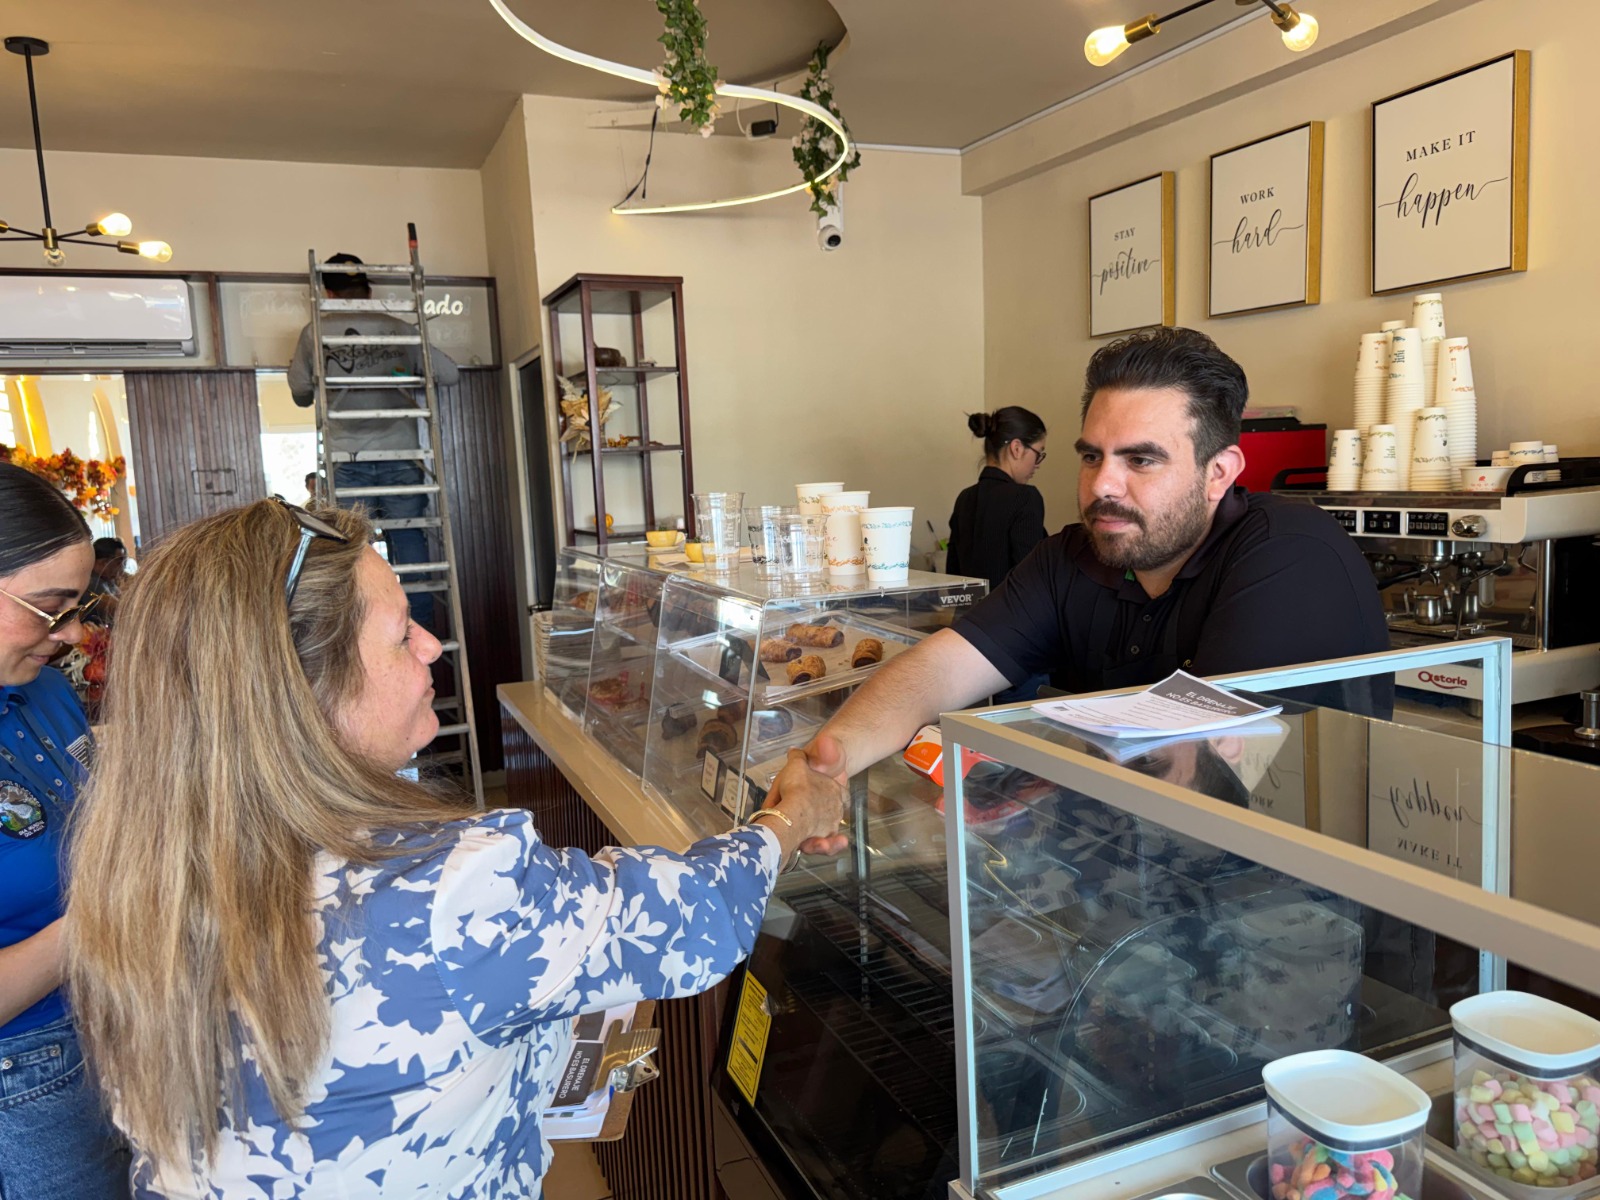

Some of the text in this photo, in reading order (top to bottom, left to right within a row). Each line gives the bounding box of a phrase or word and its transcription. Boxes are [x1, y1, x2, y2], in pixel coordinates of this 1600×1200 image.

[1405, 130, 1477, 162] MAKE IT
[1240, 187, 1275, 205] WORK
[1378, 172, 1509, 229] happen
[1114, 227, 1136, 241] STAY
[1213, 208, 1304, 254] hard
[1092, 247, 1160, 296] positive
[940, 594, 972, 604] VEVOR
[1166, 692, 1181, 700] NO
[1185, 691, 1197, 699] EL
[575, 1050, 583, 1059] NO
[559, 1067, 577, 1099] BASURERO
[572, 1065, 587, 1091] DRENAJE
